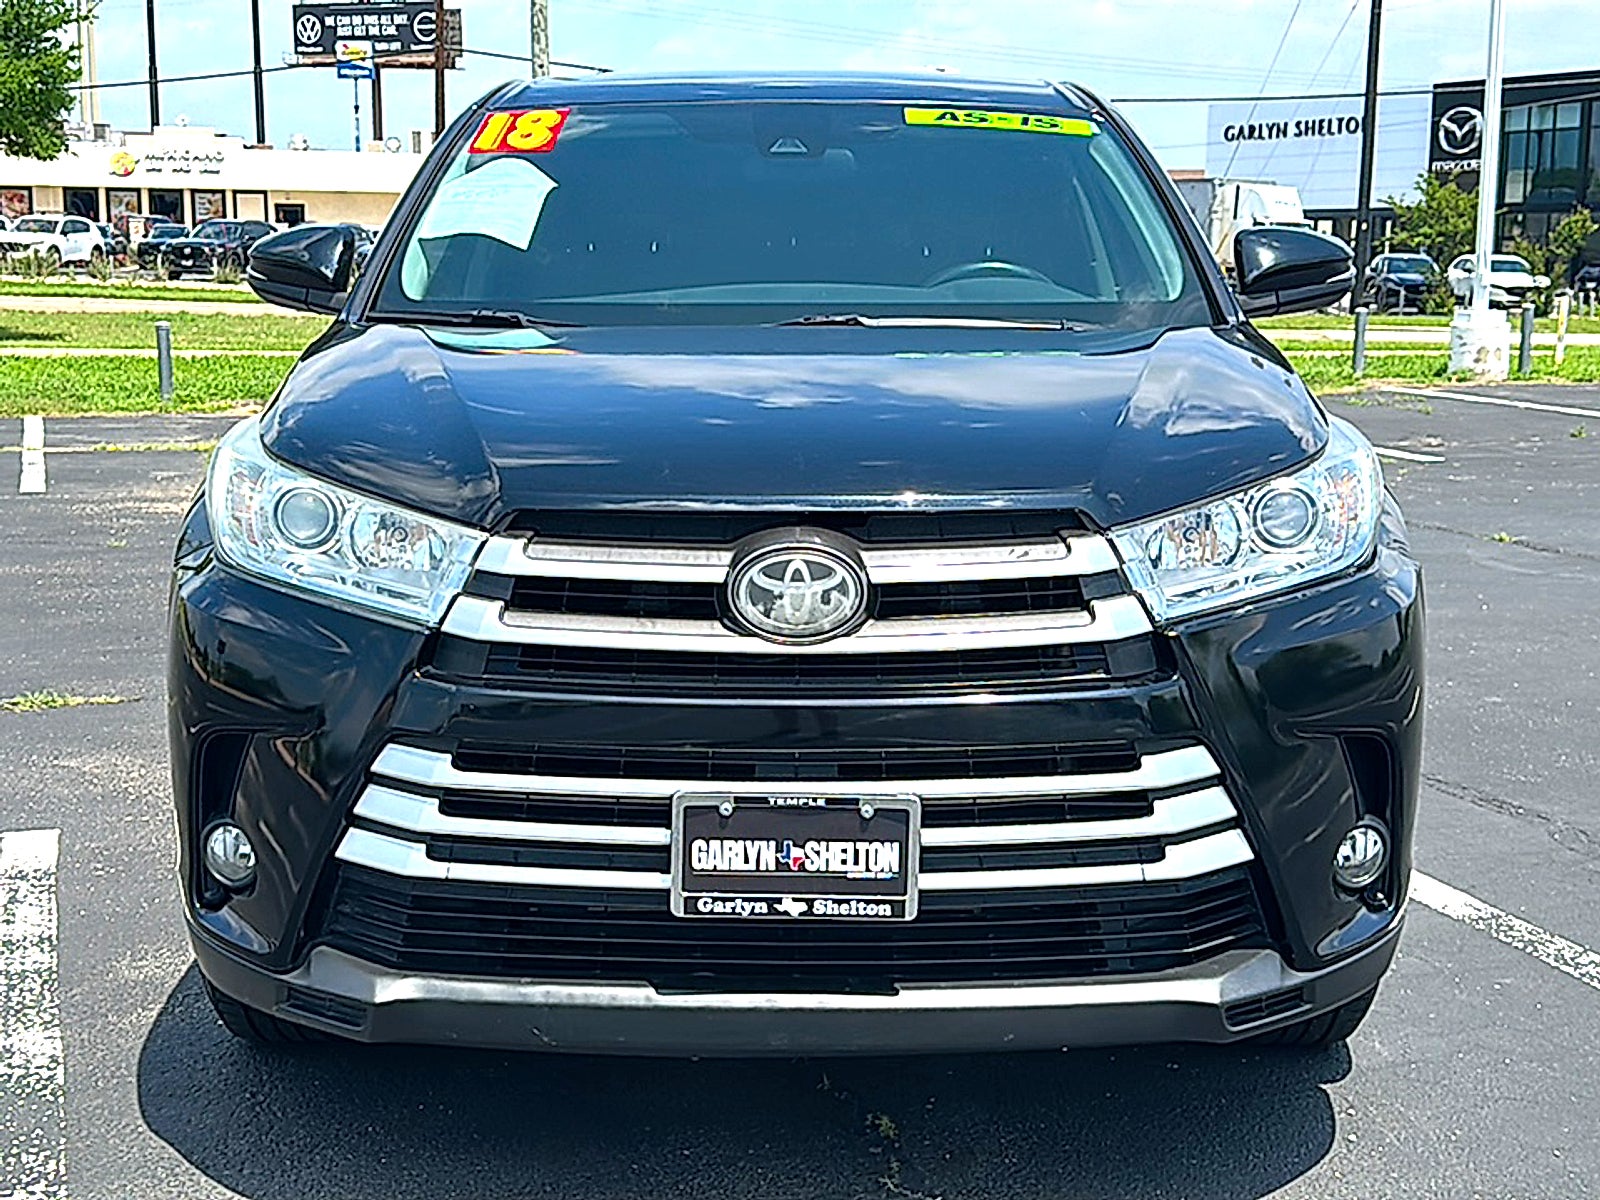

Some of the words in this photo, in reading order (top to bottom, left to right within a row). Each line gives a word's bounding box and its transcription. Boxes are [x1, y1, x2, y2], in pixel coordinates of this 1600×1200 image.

[473, 110, 563, 151] 18
[1223, 121, 1288, 142] GARLYN
[1293, 116, 1363, 138] SHELTO
[767, 797, 827, 807] TEMPLE
[691, 839, 776, 871] GARLYN
[804, 840, 900, 872] SHELTON
[697, 898, 768, 917] Garlyn
[812, 899, 892, 916] Shelton
